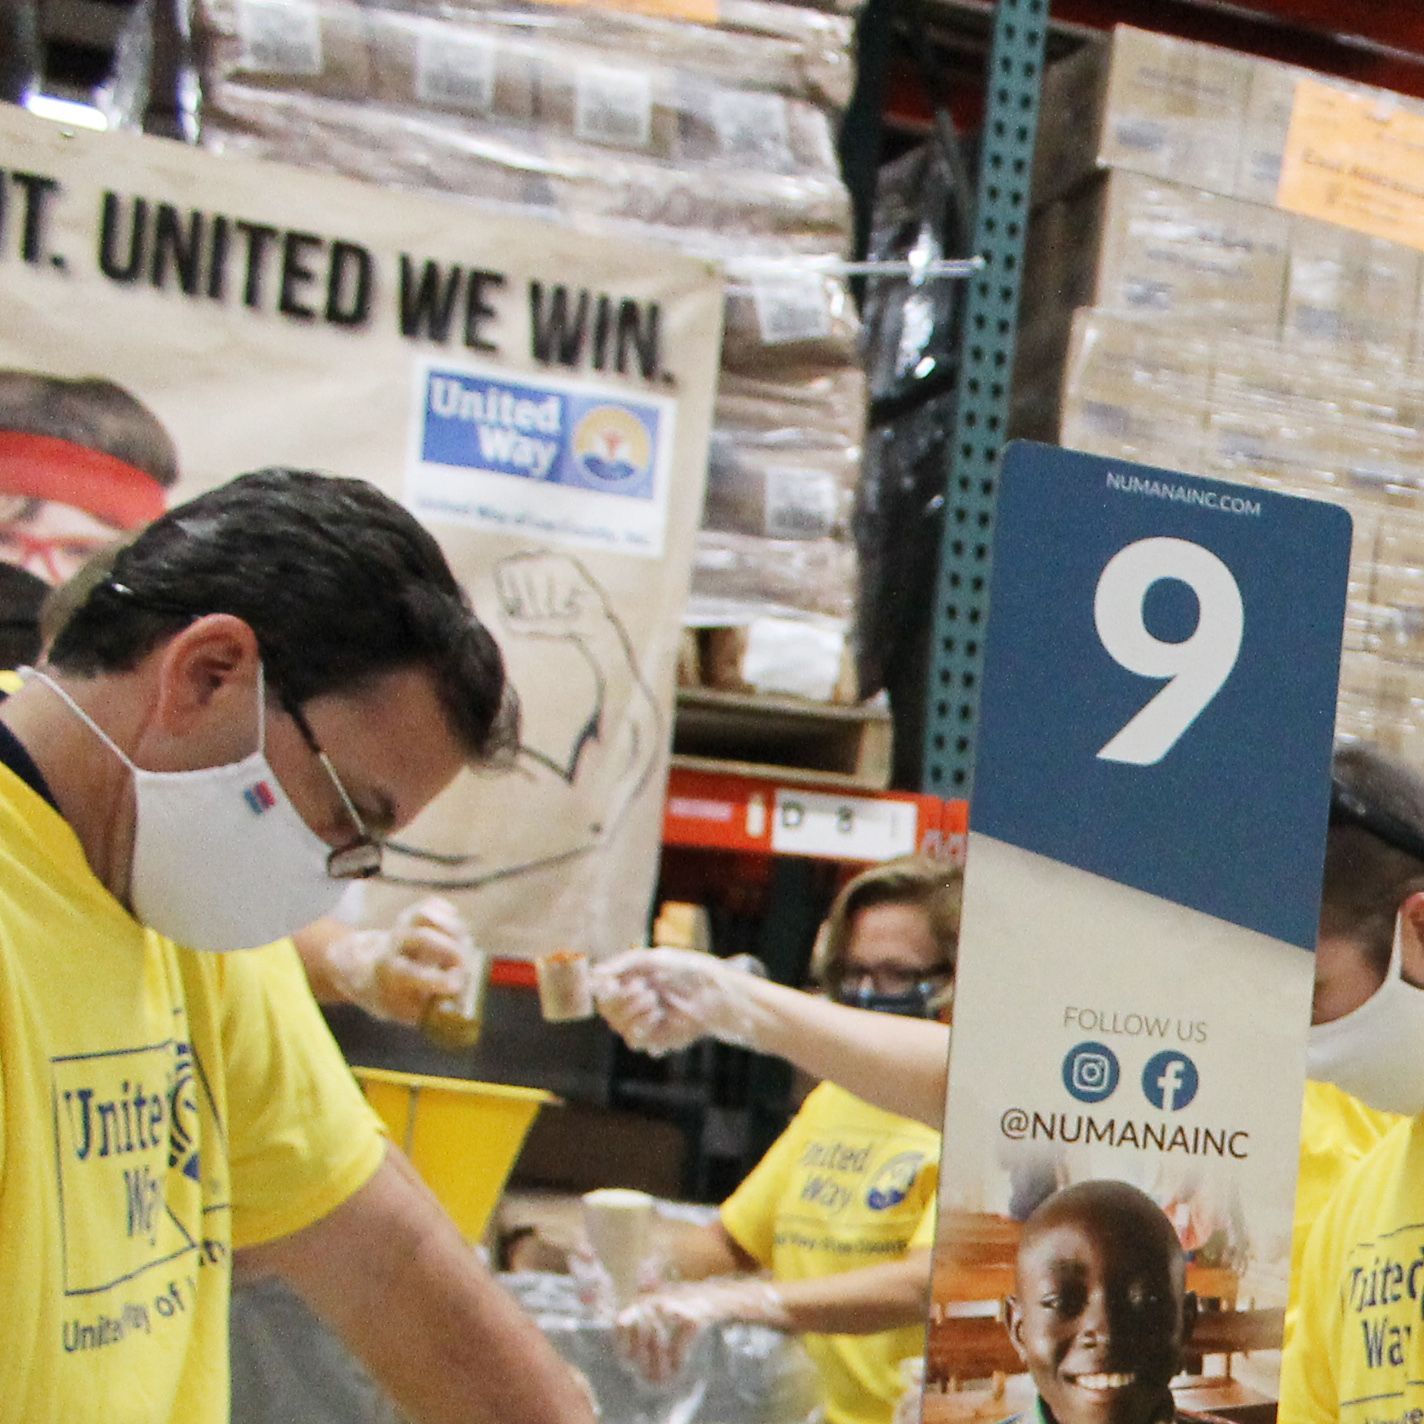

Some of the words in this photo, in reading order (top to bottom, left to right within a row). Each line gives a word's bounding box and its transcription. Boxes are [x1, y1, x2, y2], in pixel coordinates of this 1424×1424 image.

[98, 189, 371, 328] UNITED
[398, 252, 505, 352] WE
[528, 280, 676, 386] WIN.
[430, 377, 561, 435] United
[479, 424, 558, 479] Way
[1106, 471, 1261, 517] NUMANAINC.COM
[1093, 536, 1245, 766] 9
[1063, 1005, 1170, 1039] FOLLOW
[1176, 1019, 1208, 1043] US
[1000, 1107, 1250, 1160] @NUMANAINC
